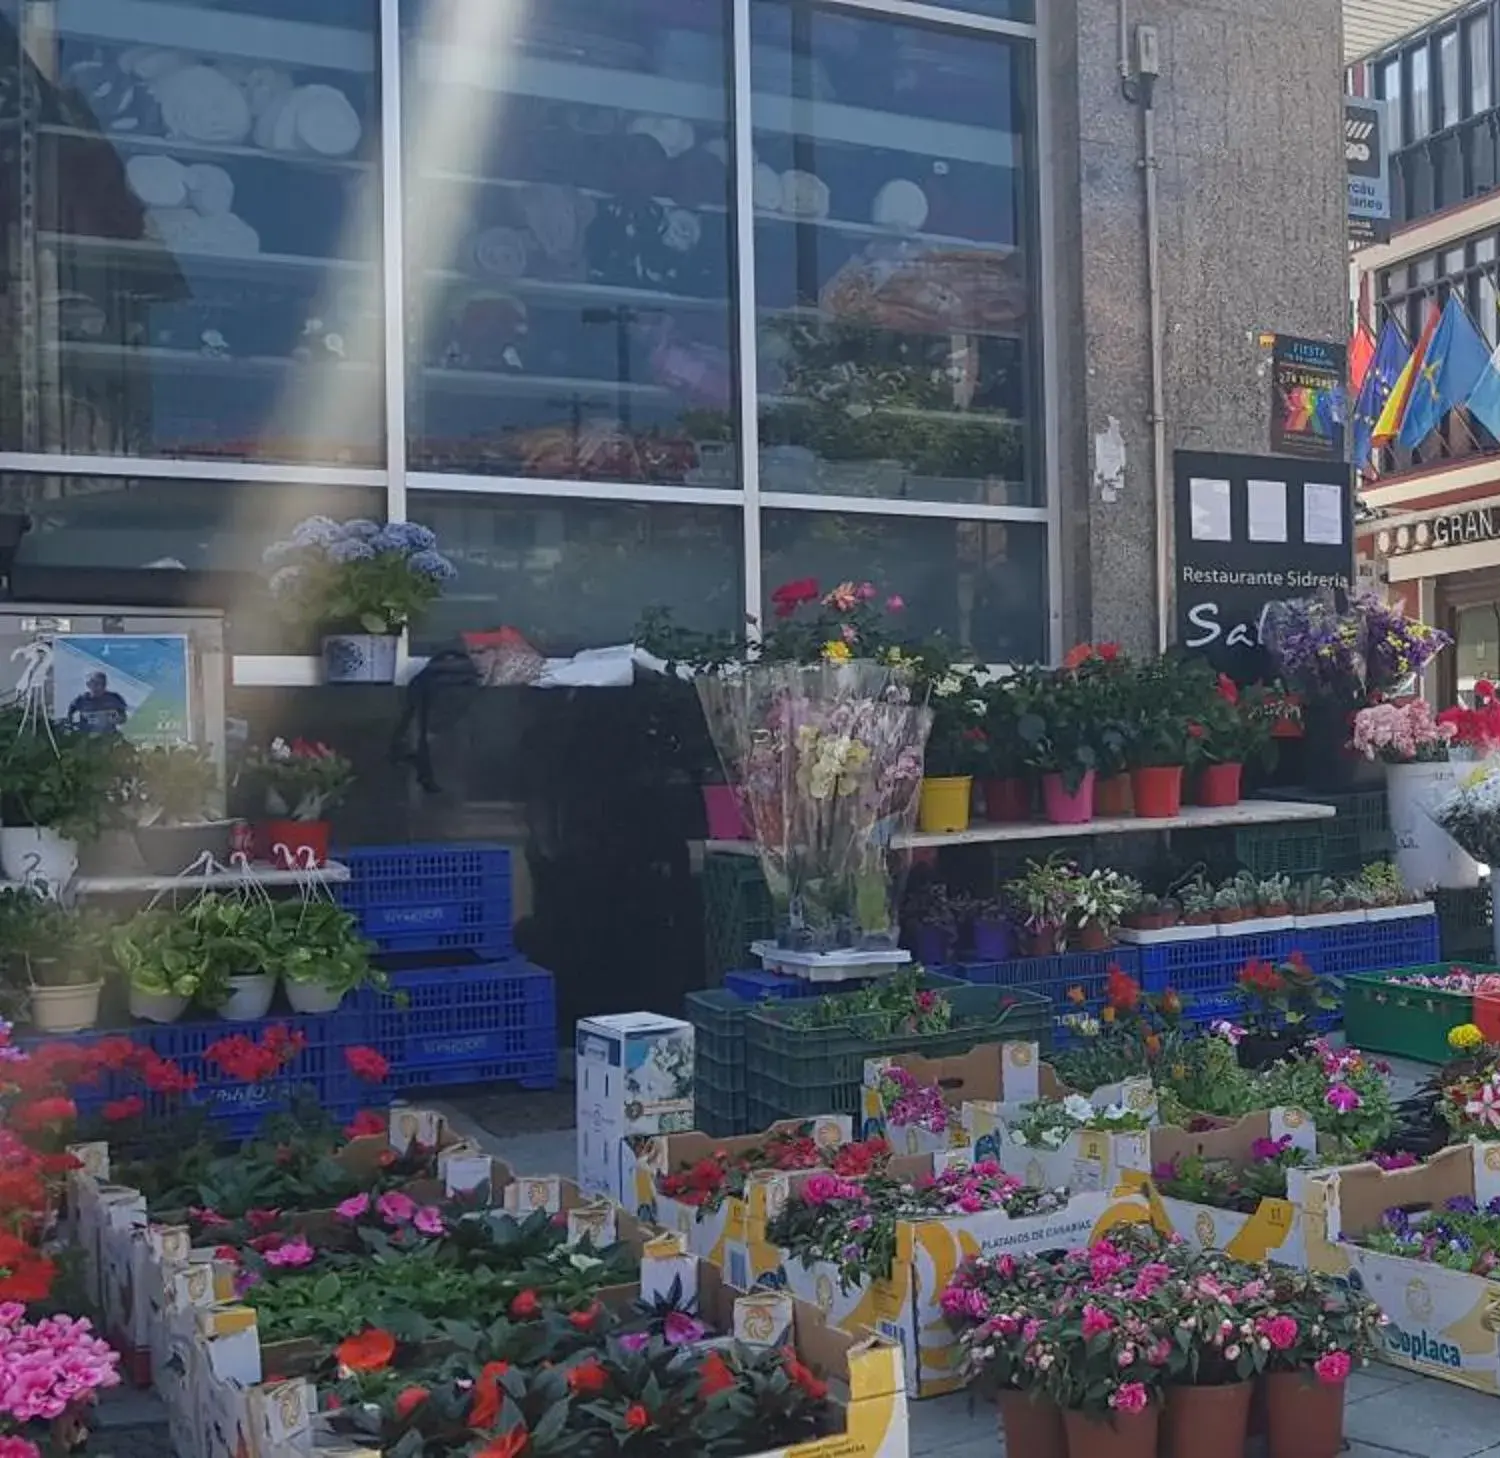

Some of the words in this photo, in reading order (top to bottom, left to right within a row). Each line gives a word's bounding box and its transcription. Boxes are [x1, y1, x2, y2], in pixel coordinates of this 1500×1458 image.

[1347, 183, 1375, 196] rcáu
[1433, 507, 1494, 546] GRAN
[1183, 566, 1284, 586] Restaurante
[1186, 602, 1271, 648] Sal
